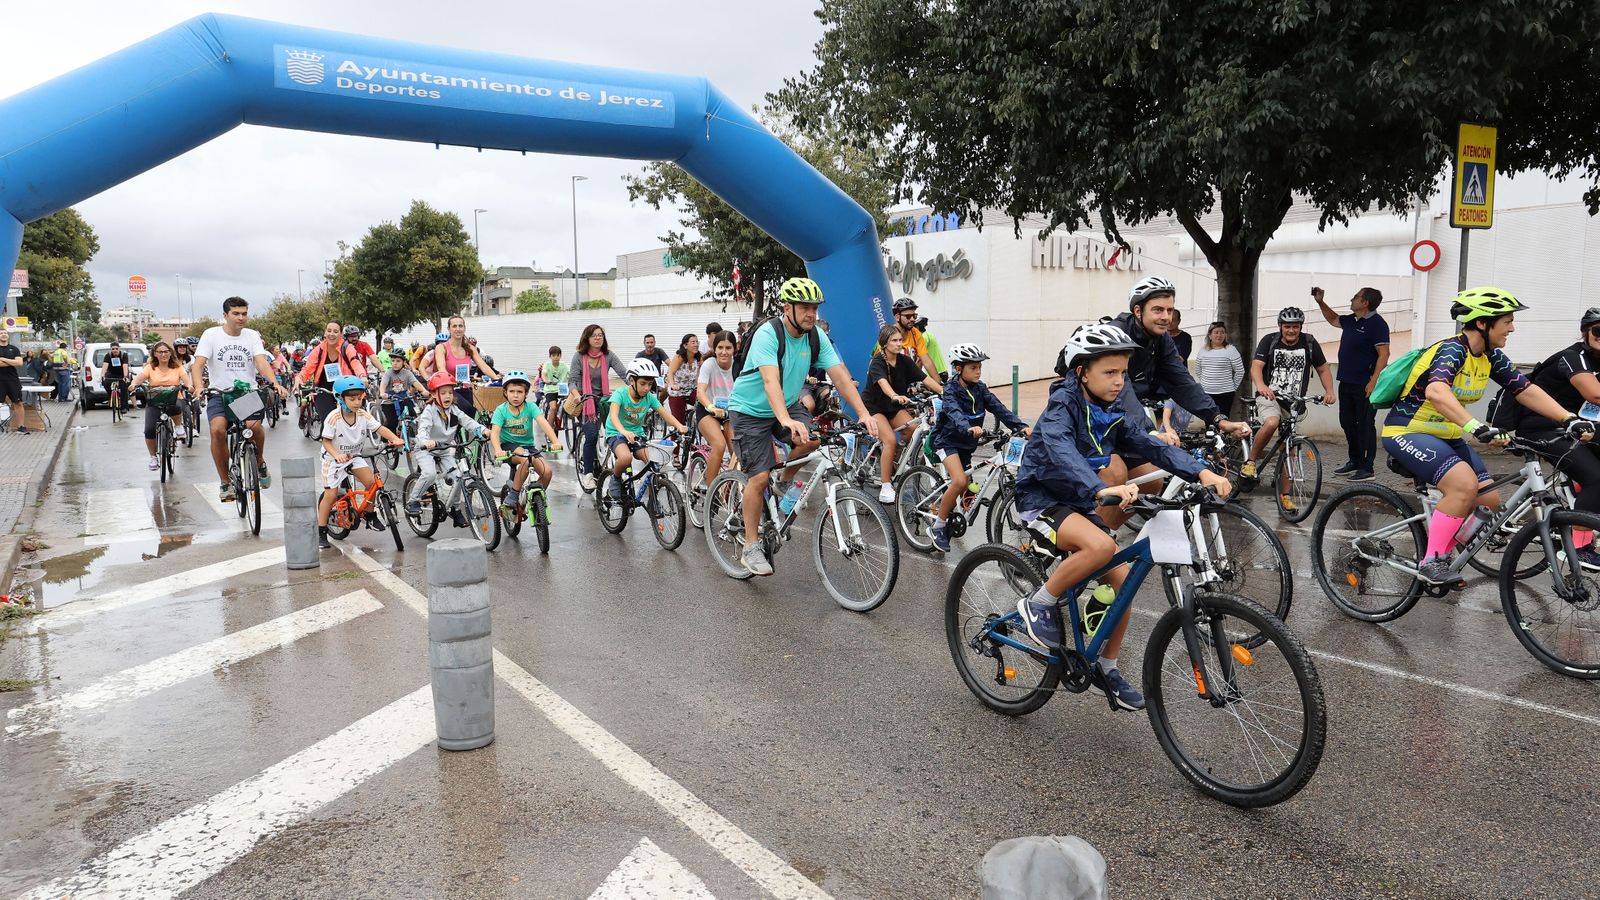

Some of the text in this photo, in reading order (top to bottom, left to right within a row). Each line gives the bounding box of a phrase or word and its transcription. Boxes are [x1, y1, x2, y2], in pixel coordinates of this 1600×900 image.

[336, 60, 664, 109] Ayuntamiento de Jerez
[336, 77, 441, 99] Deportes
[1462, 143, 1492, 159] ATENCIÓN
[1458, 207, 1488, 223] PEATONES
[872, 296, 887, 330] deporte
[217, 344, 253, 362] ABERCROMBIE
[1391, 434, 1428, 462] uajerez
